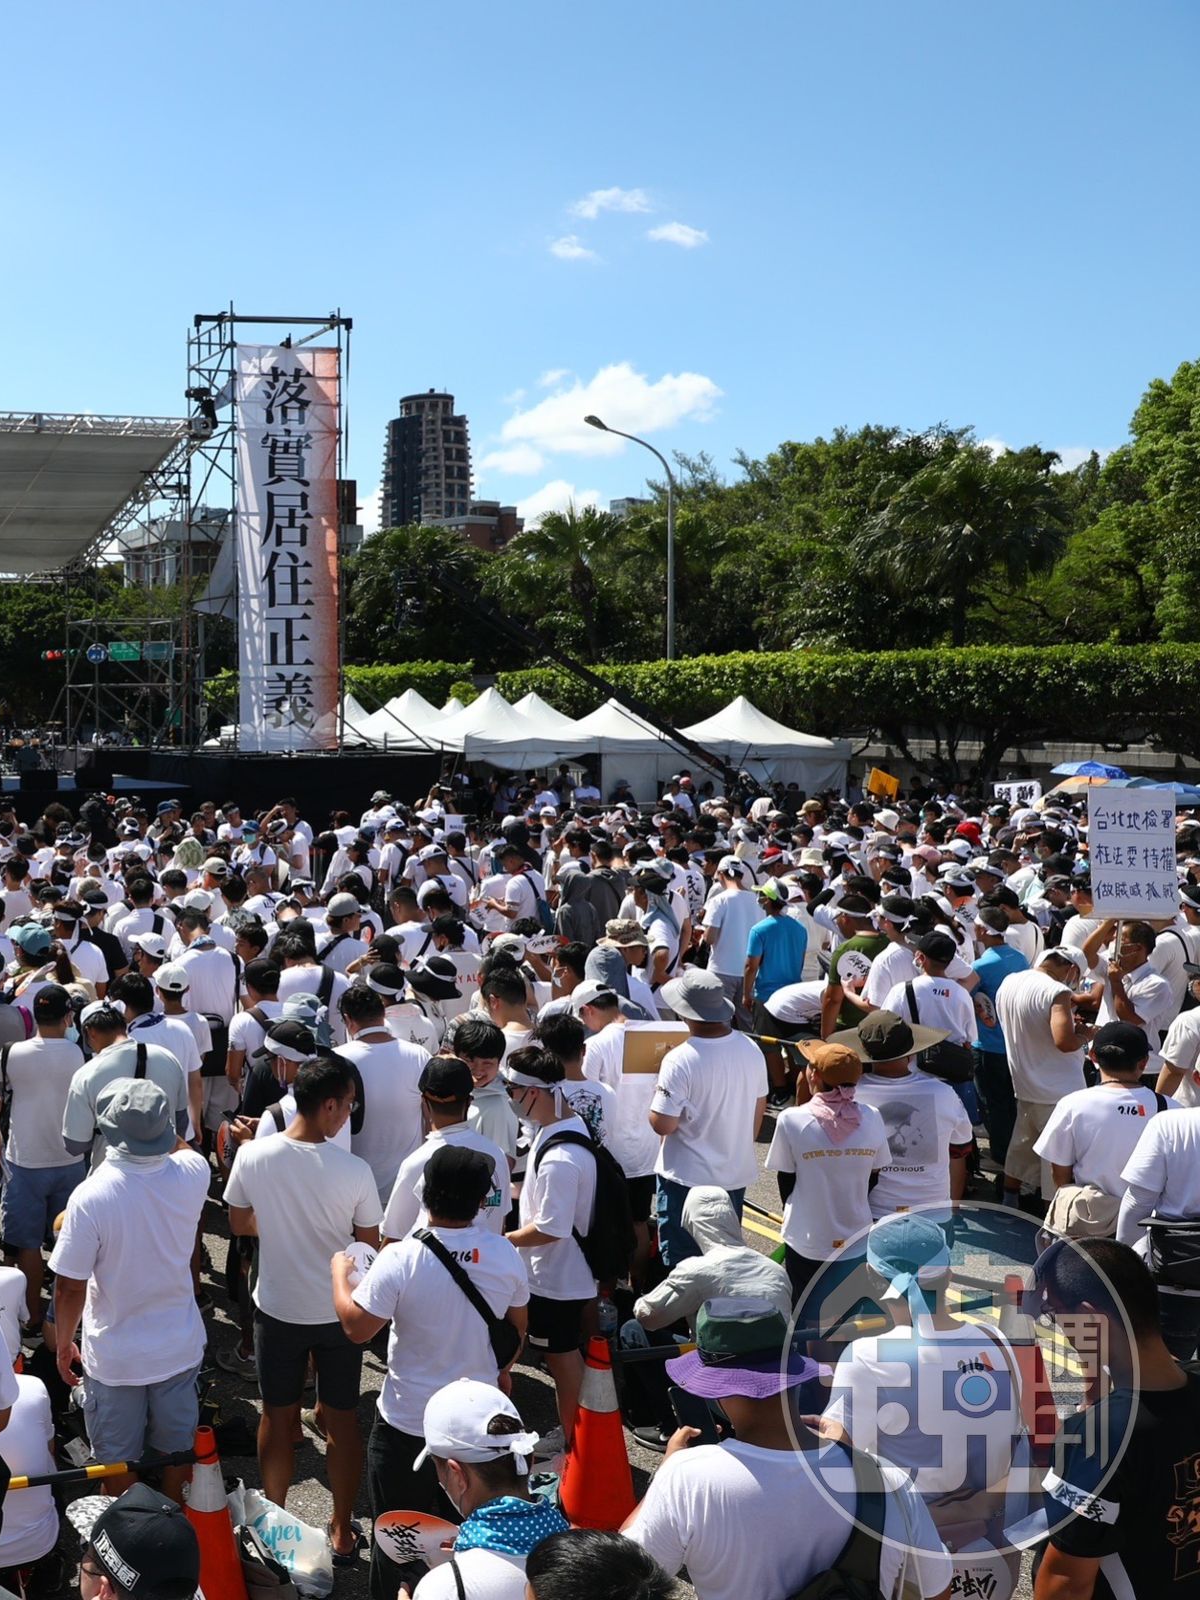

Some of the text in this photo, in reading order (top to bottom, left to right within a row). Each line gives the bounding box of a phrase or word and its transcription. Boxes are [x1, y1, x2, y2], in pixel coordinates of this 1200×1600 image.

[261, 366, 316, 729] 落實居住正義
[1094, 806, 1173, 831] 台北地檢署
[1117, 1105, 1138, 1116] 7.16
[879, 1165, 925, 1173] OTORIOUS
